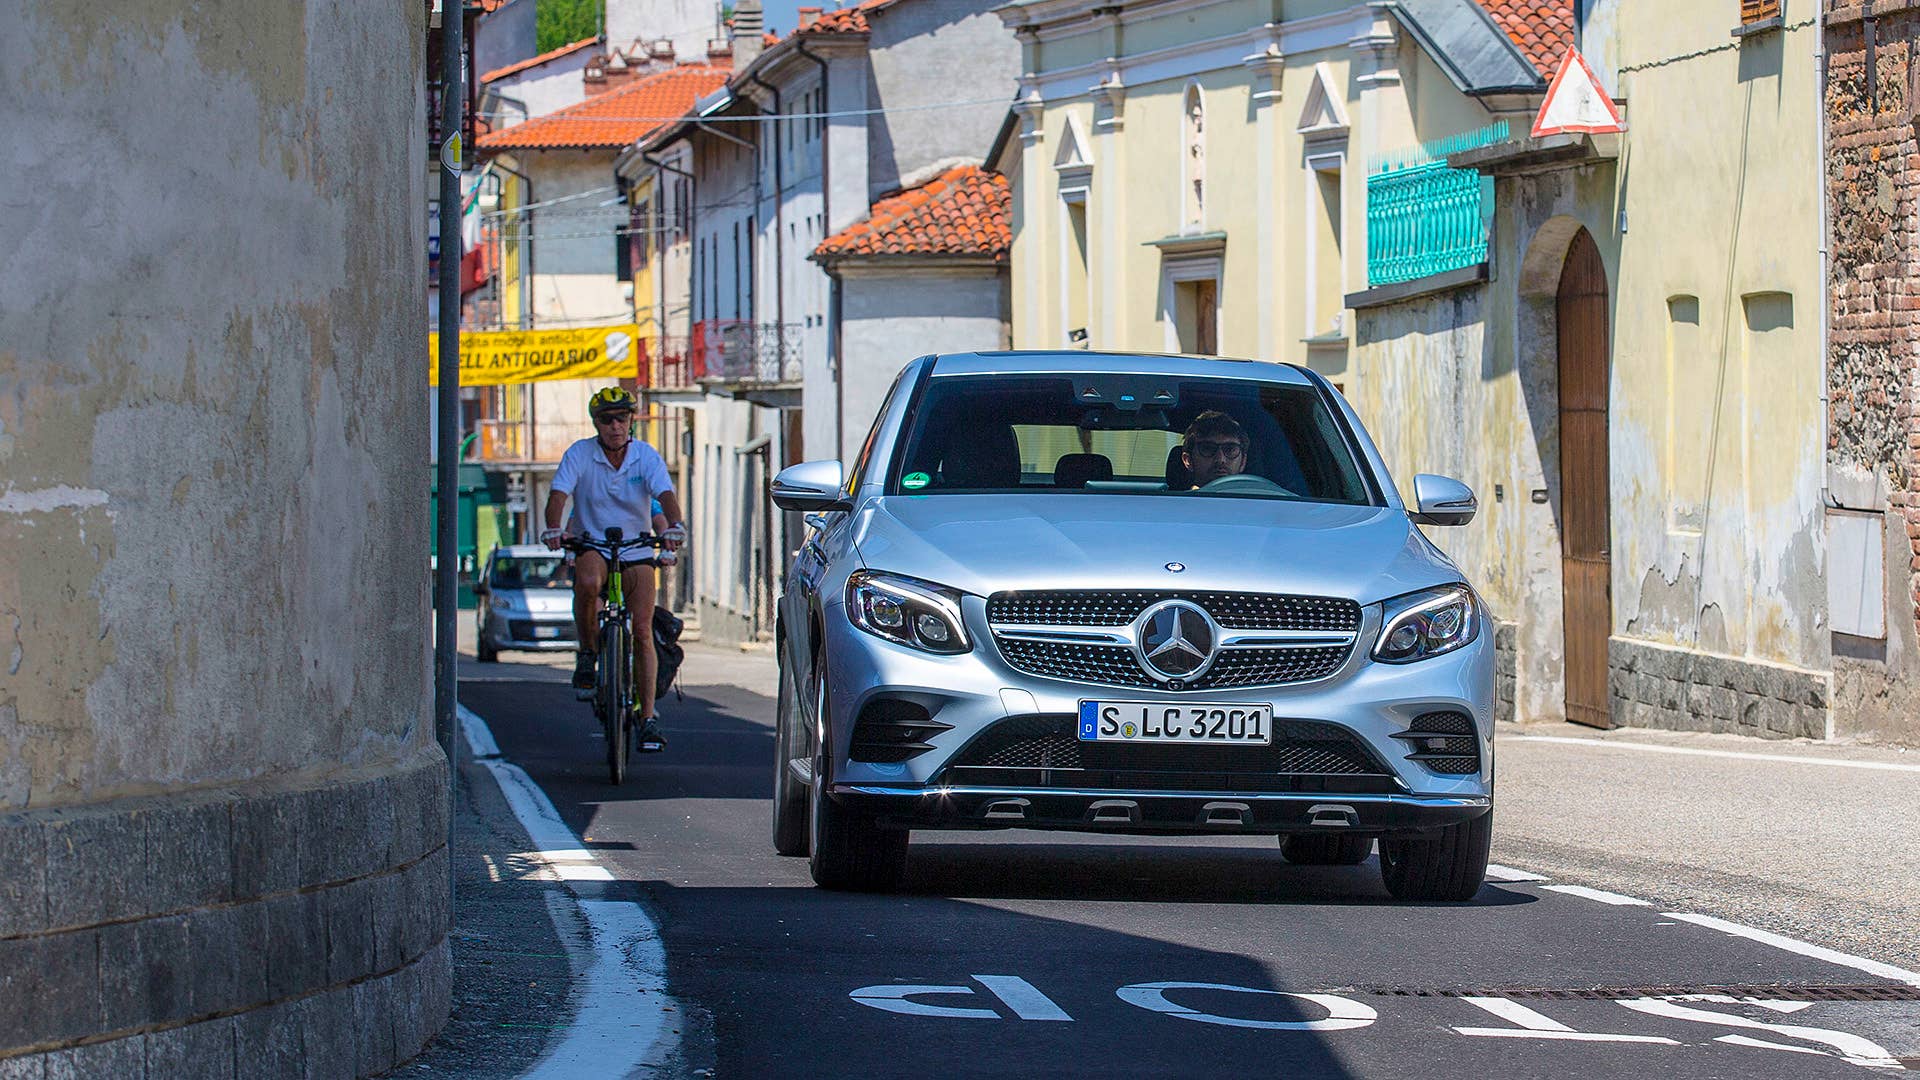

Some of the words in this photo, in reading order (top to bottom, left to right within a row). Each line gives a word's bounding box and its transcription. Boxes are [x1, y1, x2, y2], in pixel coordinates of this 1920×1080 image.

[1085, 724, 1093, 733] D
[1100, 706, 1120, 736] S
[1142, 707, 1182, 737] LC
[1189, 709, 1265, 740] 3201
